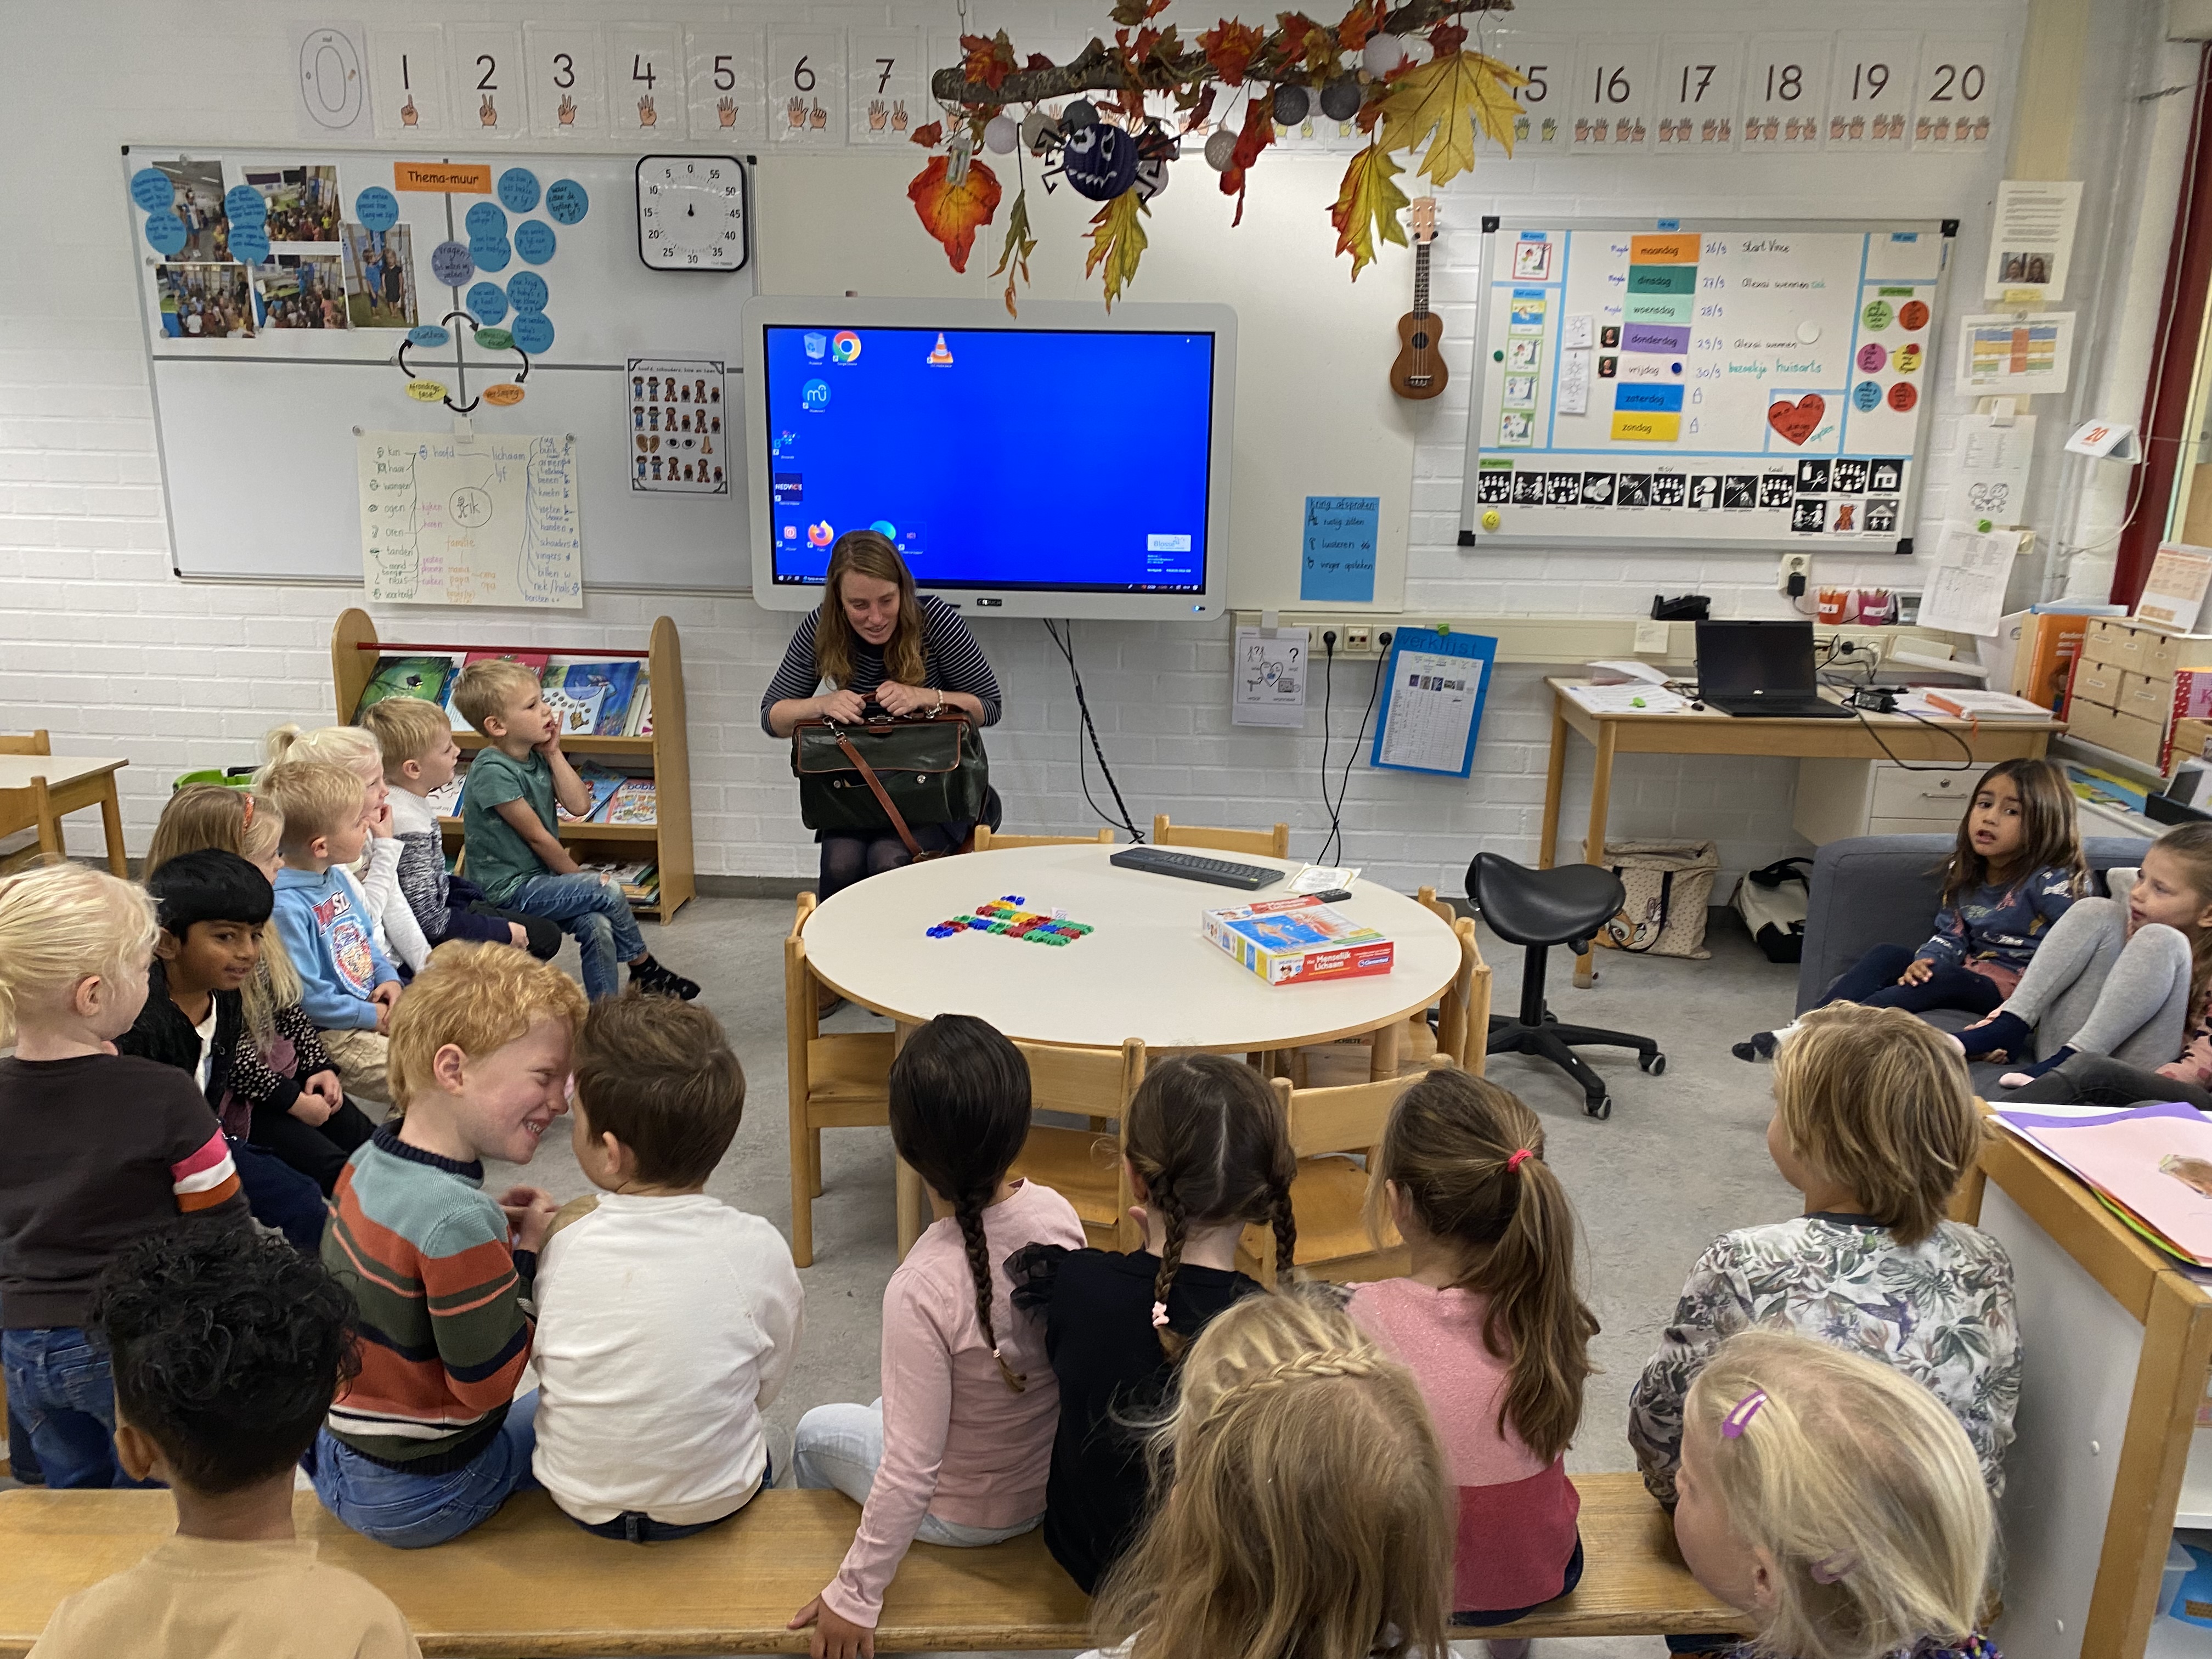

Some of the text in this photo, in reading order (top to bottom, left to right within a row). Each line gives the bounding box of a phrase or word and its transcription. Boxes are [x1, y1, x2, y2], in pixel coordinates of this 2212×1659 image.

[403, 55, 409, 89] 1
[477, 55, 497, 89] 2
[554, 54, 574, 88] 3
[633, 54, 656, 89] 4
[714, 55, 736, 91] 5
[794, 55, 815, 91] 6
[876, 58, 895, 94] 7
[1513, 65, 1548, 103] 15
[1594, 65, 1630, 104] 16
[1680, 64, 1717, 104] 17
[1766, 64, 1803, 101] 18
[1852, 63, 1889, 100] 19
[1929, 64, 1986, 101] 20
[665, 168, 672, 178] 5
[687, 164, 693, 173] 0
[710, 170, 720, 179] 55
[407, 171, 479, 185] Thema-muur
[650, 185, 658, 195] 10
[725, 187, 736, 196] 50
[644, 207, 653, 217] 15
[729, 209, 741, 218] 45
[648, 229, 659, 239] 20
[724, 231, 736, 241] 40
[663, 247, 674, 257] 25
[713, 247, 723, 257] 35
[1640, 246, 1679, 257] maandag
[1706, 241, 1727, 256] 26/9
[1742, 239, 1767, 252] Start
[687, 255, 698, 264] 30
[1638, 275, 1672, 288] dinsdag
[1703, 275, 1725, 289] 27/9
[1633, 303, 1723, 317] woensdag 28/9
[1631, 334, 1678, 348] donderdag
[1697, 336, 1723, 351] 29/9
[1628, 358, 1822, 380] vrijdag 30/9 bezoekje huisarts
[1625, 394, 1664, 406] zaterdag
[1622, 422, 1652, 435] zondag
[2083, 427, 2110, 443] 20
[433, 445, 455, 459] hoofd
[492, 445, 526, 460] lichaam
[388, 460, 405, 473] haar
[538, 470, 559, 484] benen
[384, 504, 405, 518] ogen
[540, 519, 566, 532] handen
[1323, 517, 1365, 531] rustig zitten
[386, 527, 404, 537] oren
[445, 534, 476, 552] familie
[1322, 538, 1355, 549] luisteren
[386, 544, 413, 557] tanden
[1321, 558, 1373, 573] vinger opsteken
[1398, 633, 1477, 657] werklijst
[1316, 951, 1351, 964] Menselijk
[1314, 961, 1344, 971] Lichaam
